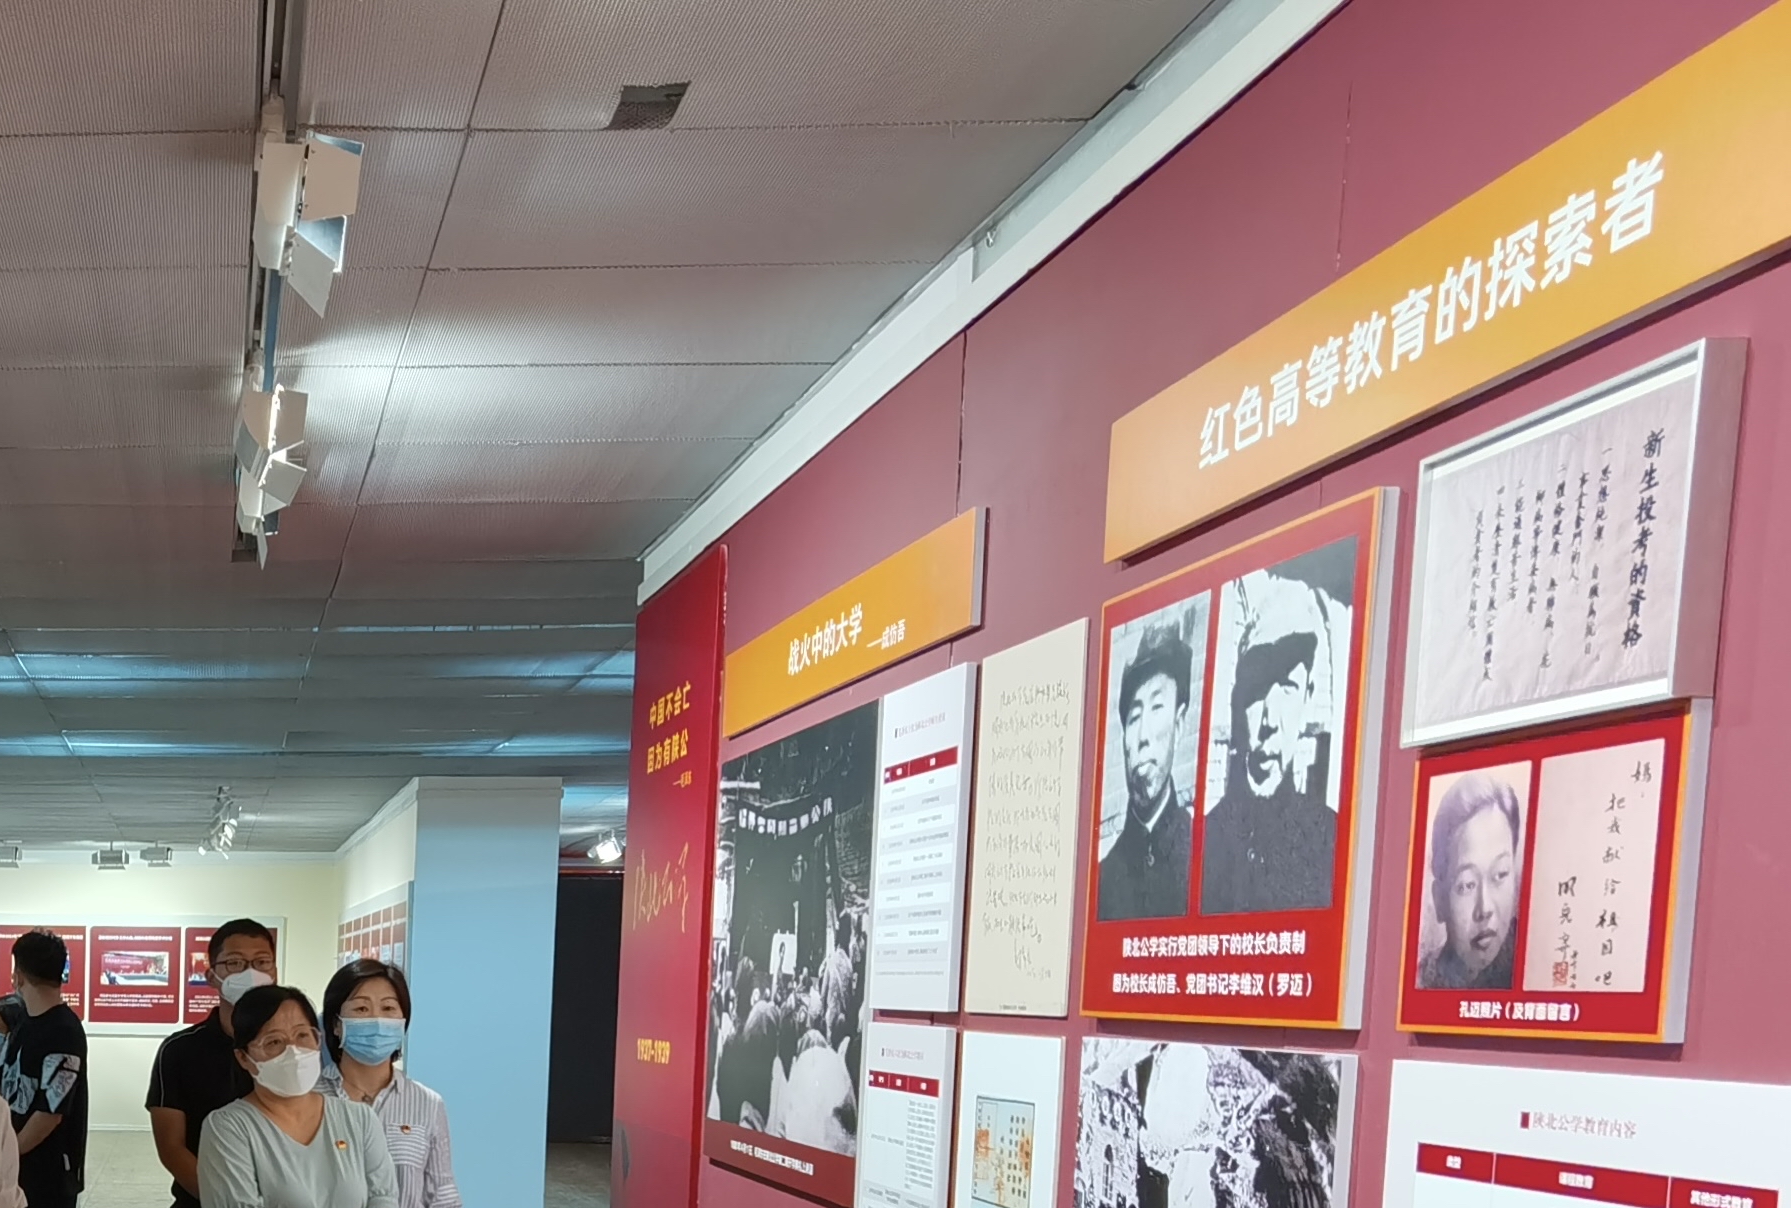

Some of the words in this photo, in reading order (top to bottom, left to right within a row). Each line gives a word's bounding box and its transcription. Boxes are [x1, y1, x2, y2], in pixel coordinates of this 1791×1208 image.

[1198, 152, 1664, 469] 红色高等教育的探索者
[788, 602, 862, 676] 战火中的大学
[649, 680, 692, 730] 中国不会亡
[646, 728, 689, 775] 因为有陕公
[1122, 930, 1306, 958] 陕北公学实行党团领导下的校长负责制
[637, 1037, 671, 1065] 1937-1939
[1532, 1112, 1637, 1139] 陕北公学教育内容
